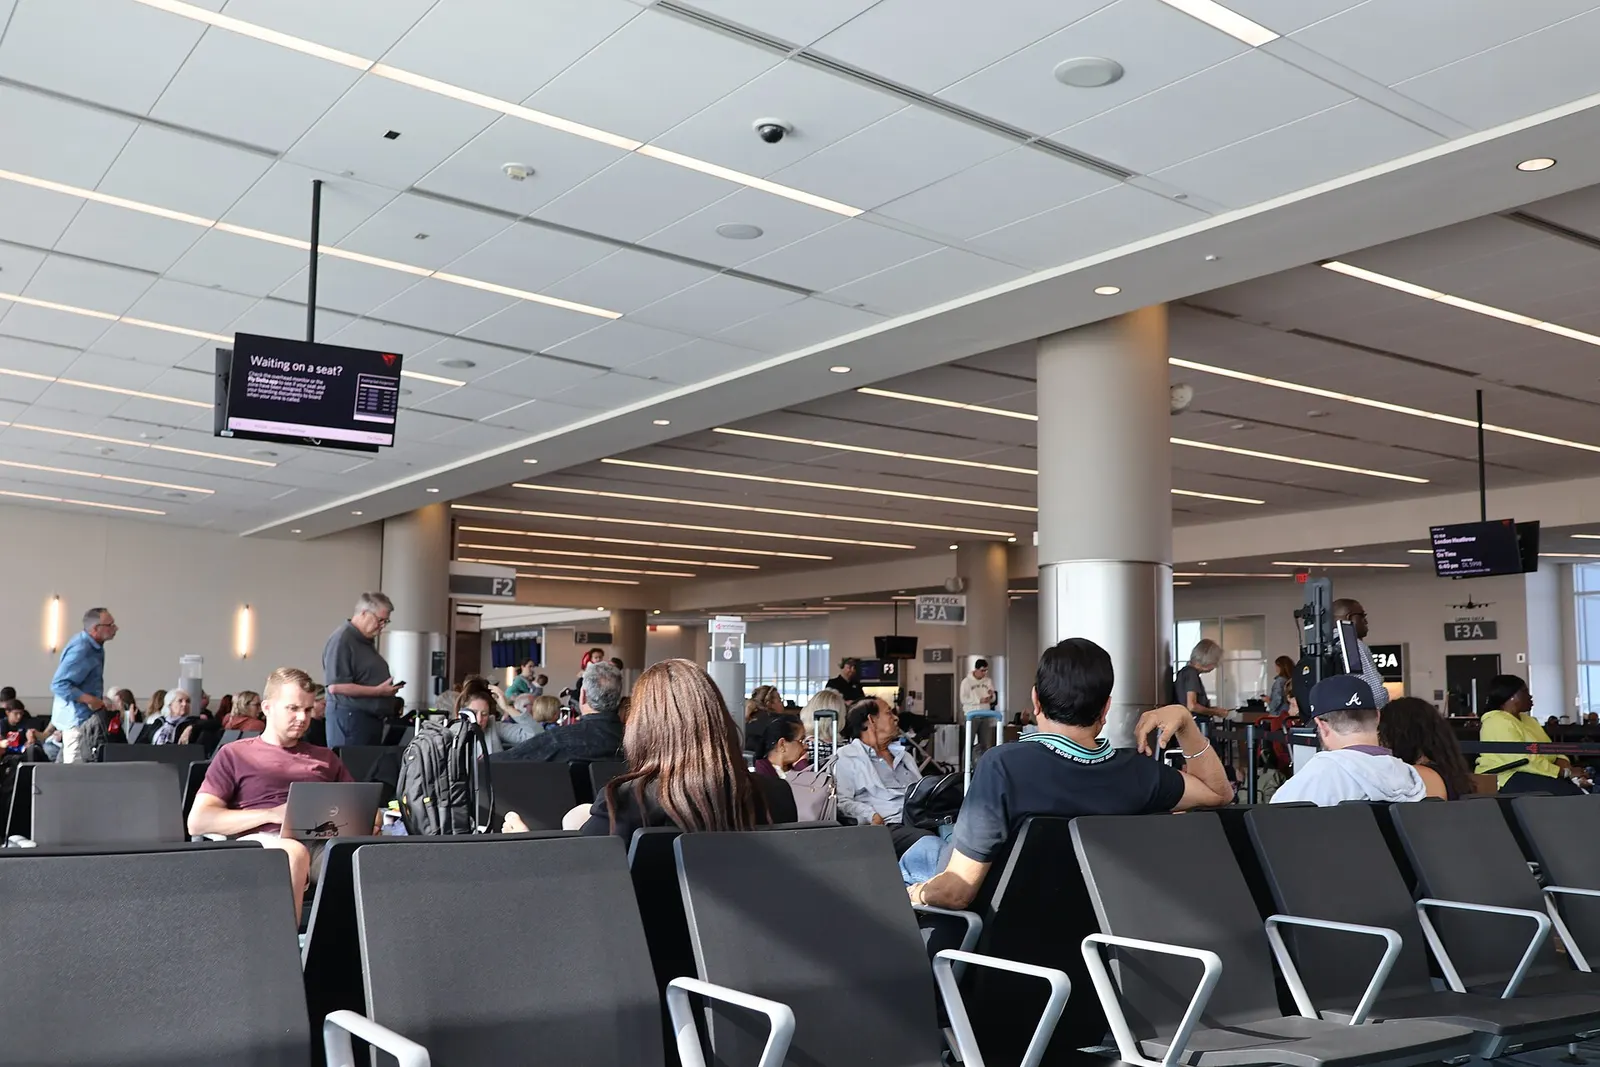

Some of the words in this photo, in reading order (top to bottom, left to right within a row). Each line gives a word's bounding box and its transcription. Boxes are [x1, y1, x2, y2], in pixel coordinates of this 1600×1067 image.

[250, 355, 290, 371] Waiting
[292, 363, 305, 371] on
[307, 365, 314, 373] a
[316, 364, 343, 376] seat?
[492, 578, 513, 596] F2
[920, 605, 947, 620] F3A
[1454, 624, 1484, 638] F3A
[932, 650, 942, 661] F3
[883, 663, 895, 674] F3
[1345, 692, 1362, 706] A
[1055, 748, 1073, 759] BOSS
[1073, 756, 1090, 764] BOSS
